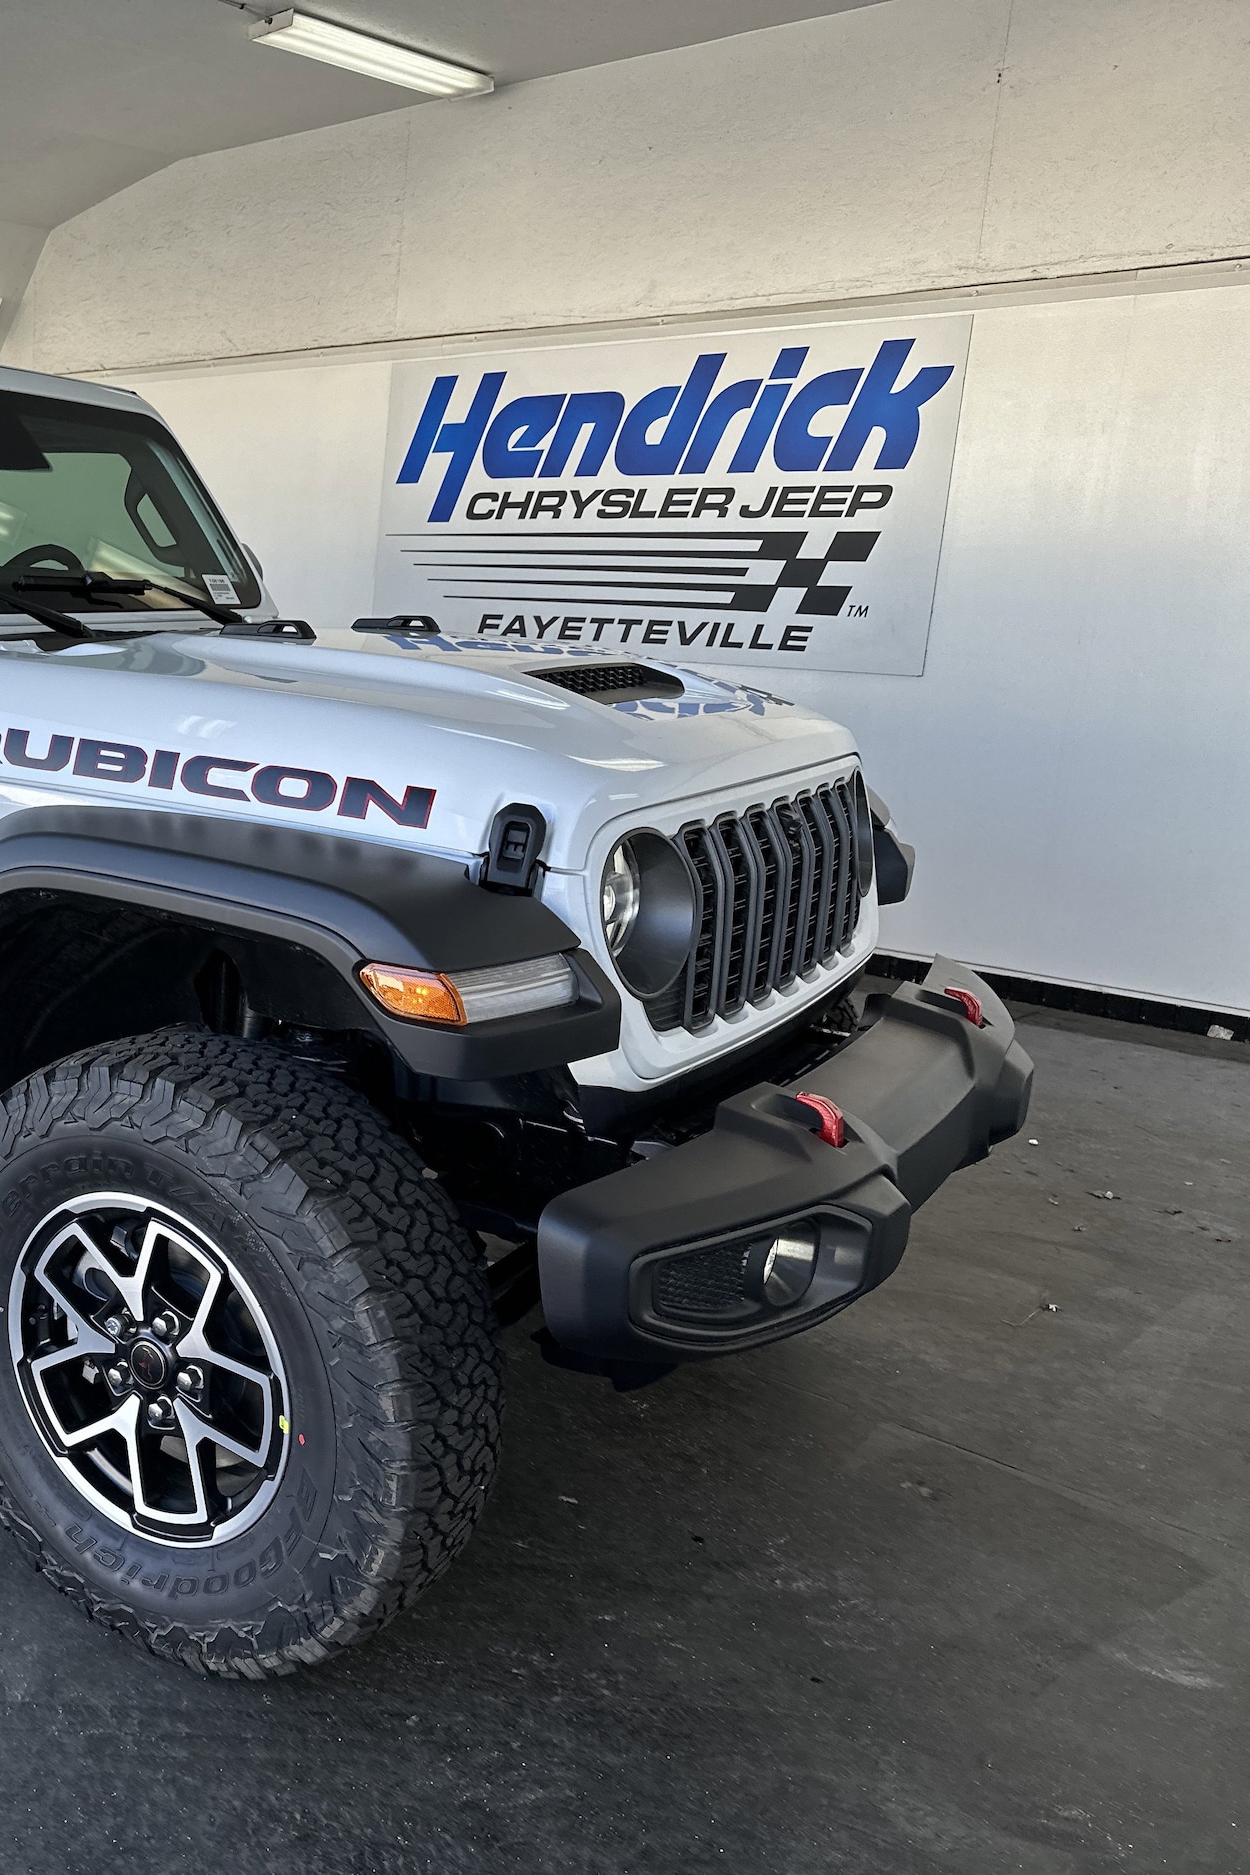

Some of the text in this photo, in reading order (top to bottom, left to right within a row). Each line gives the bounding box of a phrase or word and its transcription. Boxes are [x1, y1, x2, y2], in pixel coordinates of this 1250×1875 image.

[395, 338, 955, 522] Hendrick
[466, 484, 894, 520] CHRYSLER JEEP
[846, 604, 870, 618] TM
[477, 613, 814, 653] FAYETTEVILLE
[63, 1467, 318, 1600] BFGoodrich
